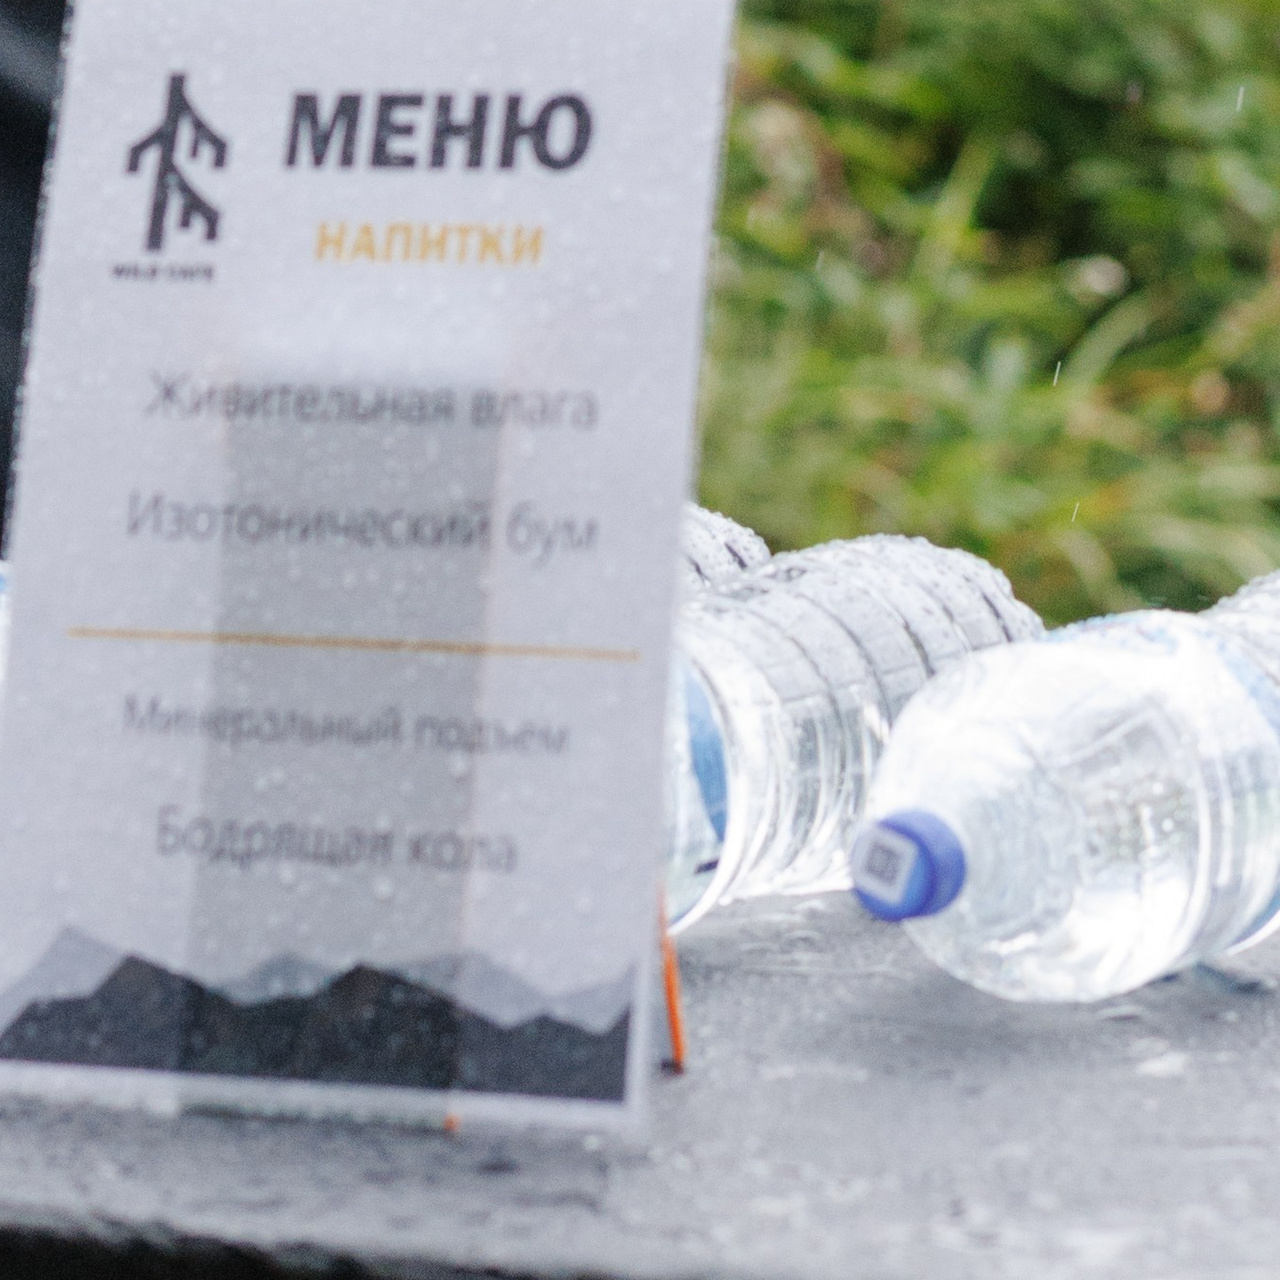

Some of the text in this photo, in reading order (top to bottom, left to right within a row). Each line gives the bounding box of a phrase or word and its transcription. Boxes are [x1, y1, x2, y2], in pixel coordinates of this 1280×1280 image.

[284, 92, 594, 172] МЕНЮ
[315, 220, 544, 266] НАПИТКИ
[143, 369, 599, 431] Живительная влага
[125, 488, 599, 567] Изотонический бум
[407, 829, 518, 874] кола
